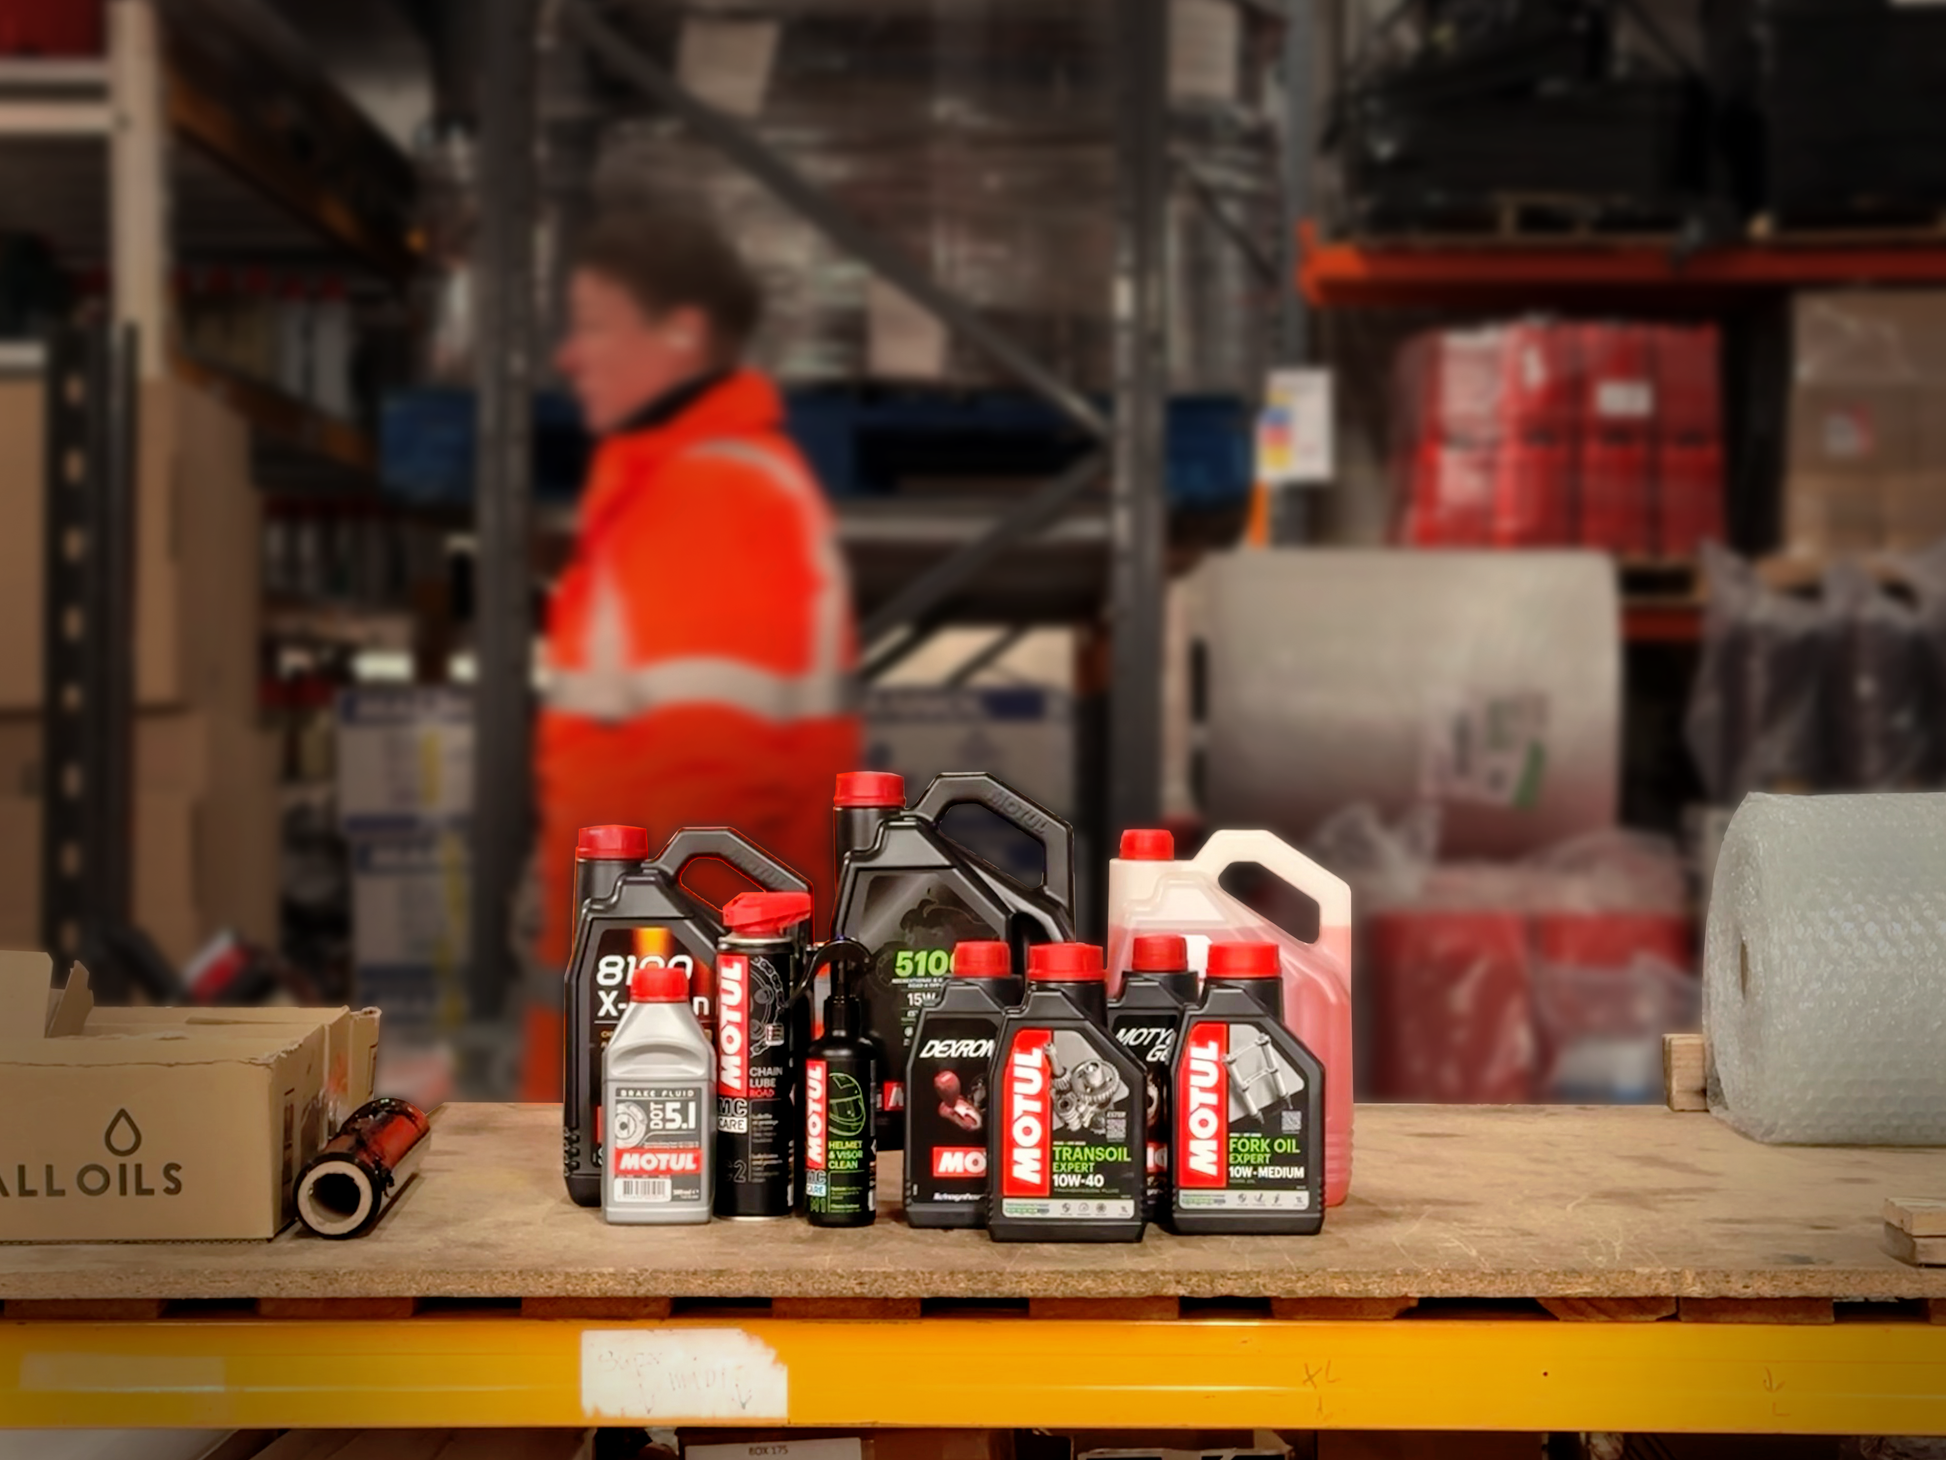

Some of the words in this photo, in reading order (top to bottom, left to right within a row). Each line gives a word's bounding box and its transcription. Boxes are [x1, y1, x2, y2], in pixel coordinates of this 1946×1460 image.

[894, 950, 956, 978] 510
[720, 962, 742, 1090] MOTUL
[749, 1067, 783, 1077] CHAIN
[749, 1078, 777, 1088] LUBE
[650, 1102, 663, 1130] DOT
[665, 1101, 696, 1130] 5.1
[807, 1066, 822, 1164] MOTUL
[1188, 1040, 1218, 1176] MOTUL
[1011, 1047, 1042, 1185] MOTUL
[829, 1140, 863, 1150] HELMET
[1229, 1138, 1271, 1153] FORK
[1273, 1138, 1301, 1153] OIL
[828, 1151, 836, 1159] &
[836, 1150, 863, 1159] VISOR
[1052, 1146, 1132, 1162] TRANSOIL
[1228, 1153, 1271, 1165] EXPERT
[620, 1153, 697, 1171] MOTUL
[828, 1160, 858, 1169] CLEAN
[1052, 1162, 1095, 1173] EXPERT
[1052, 1173, 1105, 1188] 10W-40
[1302, 1360, 1342, 1389] XL
[748, 1447, 768, 1456] BOX
[771, 1445, 788, 1455] 175
